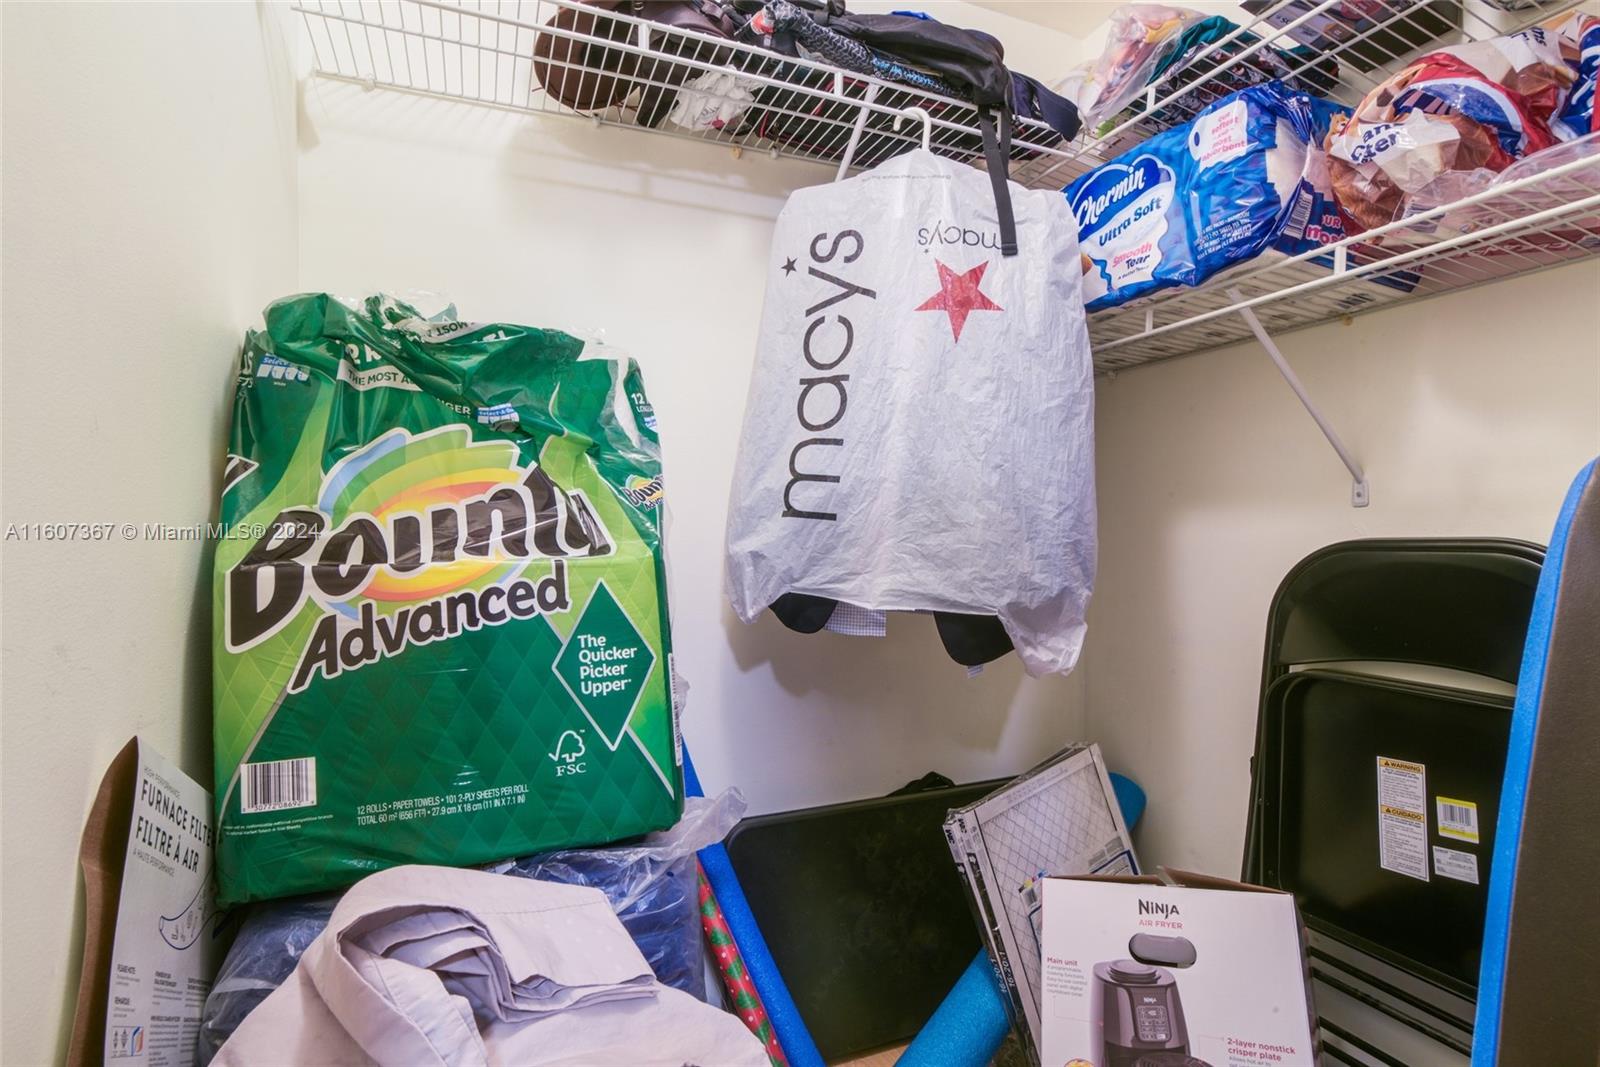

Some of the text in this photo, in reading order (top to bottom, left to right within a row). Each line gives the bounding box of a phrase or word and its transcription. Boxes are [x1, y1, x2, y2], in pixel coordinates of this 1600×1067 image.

[1076, 167, 1145, 229] Charmin
[1099, 216, 1131, 246] Ultra
[1133, 197, 1162, 223] Soft
[1126, 254, 1150, 269] Tear
[435, 321, 468, 336] MOST
[348, 369, 365, 385] THE
[367, 372, 399, 386] MOST
[631, 393, 645, 405] 12
[292, 560, 568, 690] Advanced
[577, 634, 606, 648] The
[579, 647, 637, 664] Quicker
[580, 664, 627, 679] Picker
[581, 679, 628, 697] Upper
[556, 763, 586, 776] FSC
[1391, 762, 1420, 772] WARNING
[142, 779, 187, 830] FURNACE
[357, 784, 529, 815] 12 ROLLS PAPER TOWELS 101 2-PLY SHEETS PER ROLL
[357, 815, 377, 826] TOTAL
[379, 814, 387, 823] 60
[432, 806, 446, 816] 27.9
[464, 803, 471, 812] 18
[136, 816, 173, 857] FILTRE
[182, 848, 199, 873] AIR
[1139, 919, 1183, 930] AIR FRYER
[1047, 957, 1062, 965] Main
[1227, 1037, 1296, 1055] 2-layer nonstick
[1228, 1047, 1281, 1062] crisper plate
